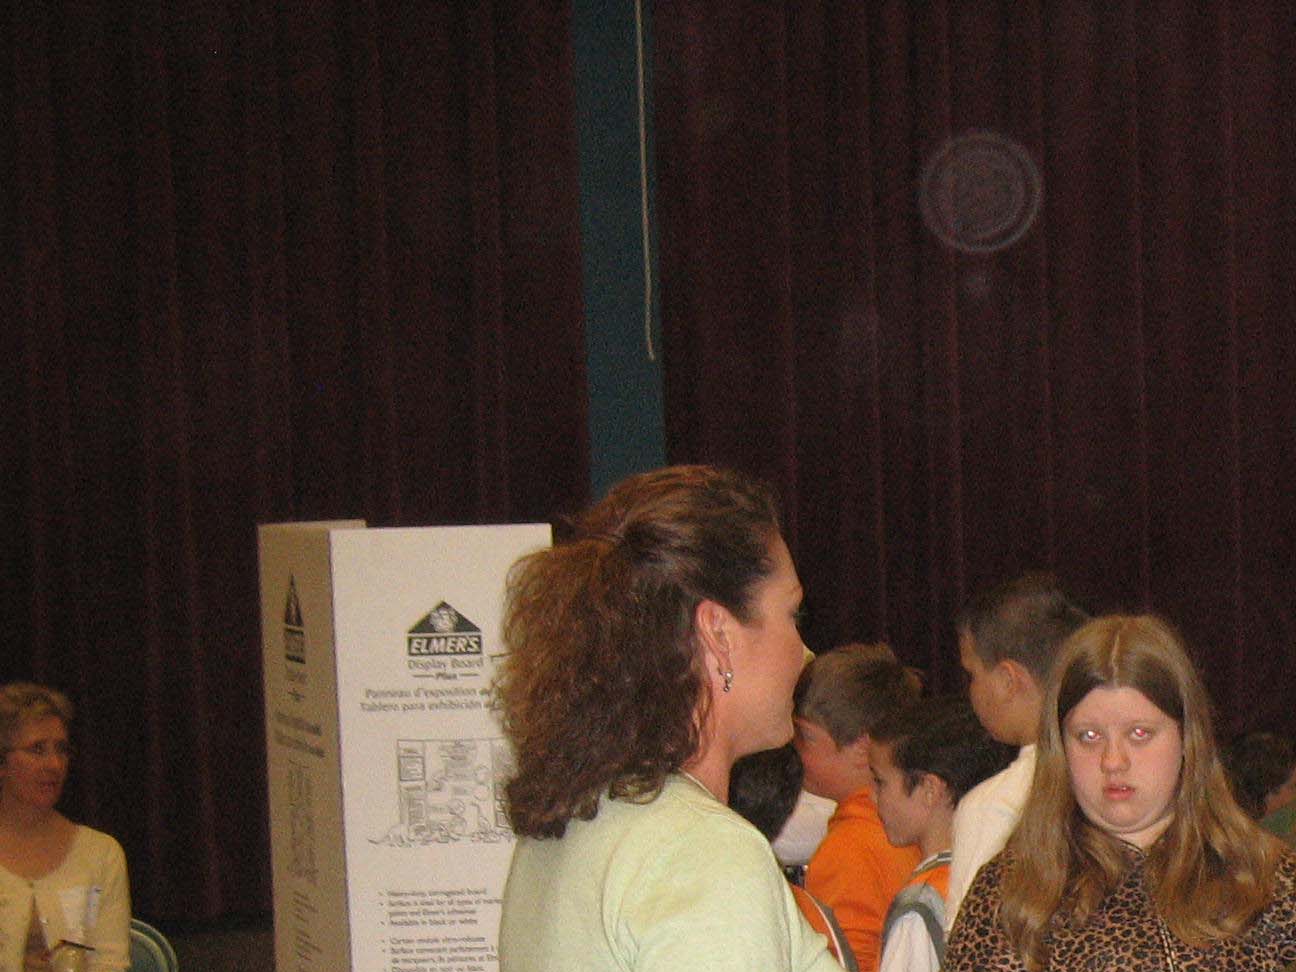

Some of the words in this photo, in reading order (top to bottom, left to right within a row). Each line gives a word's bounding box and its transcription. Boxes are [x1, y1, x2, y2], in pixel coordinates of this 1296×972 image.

[410, 636, 481, 654] ELMER'S
[408, 657, 447, 673] Display
[452, 655, 484, 669] Board
